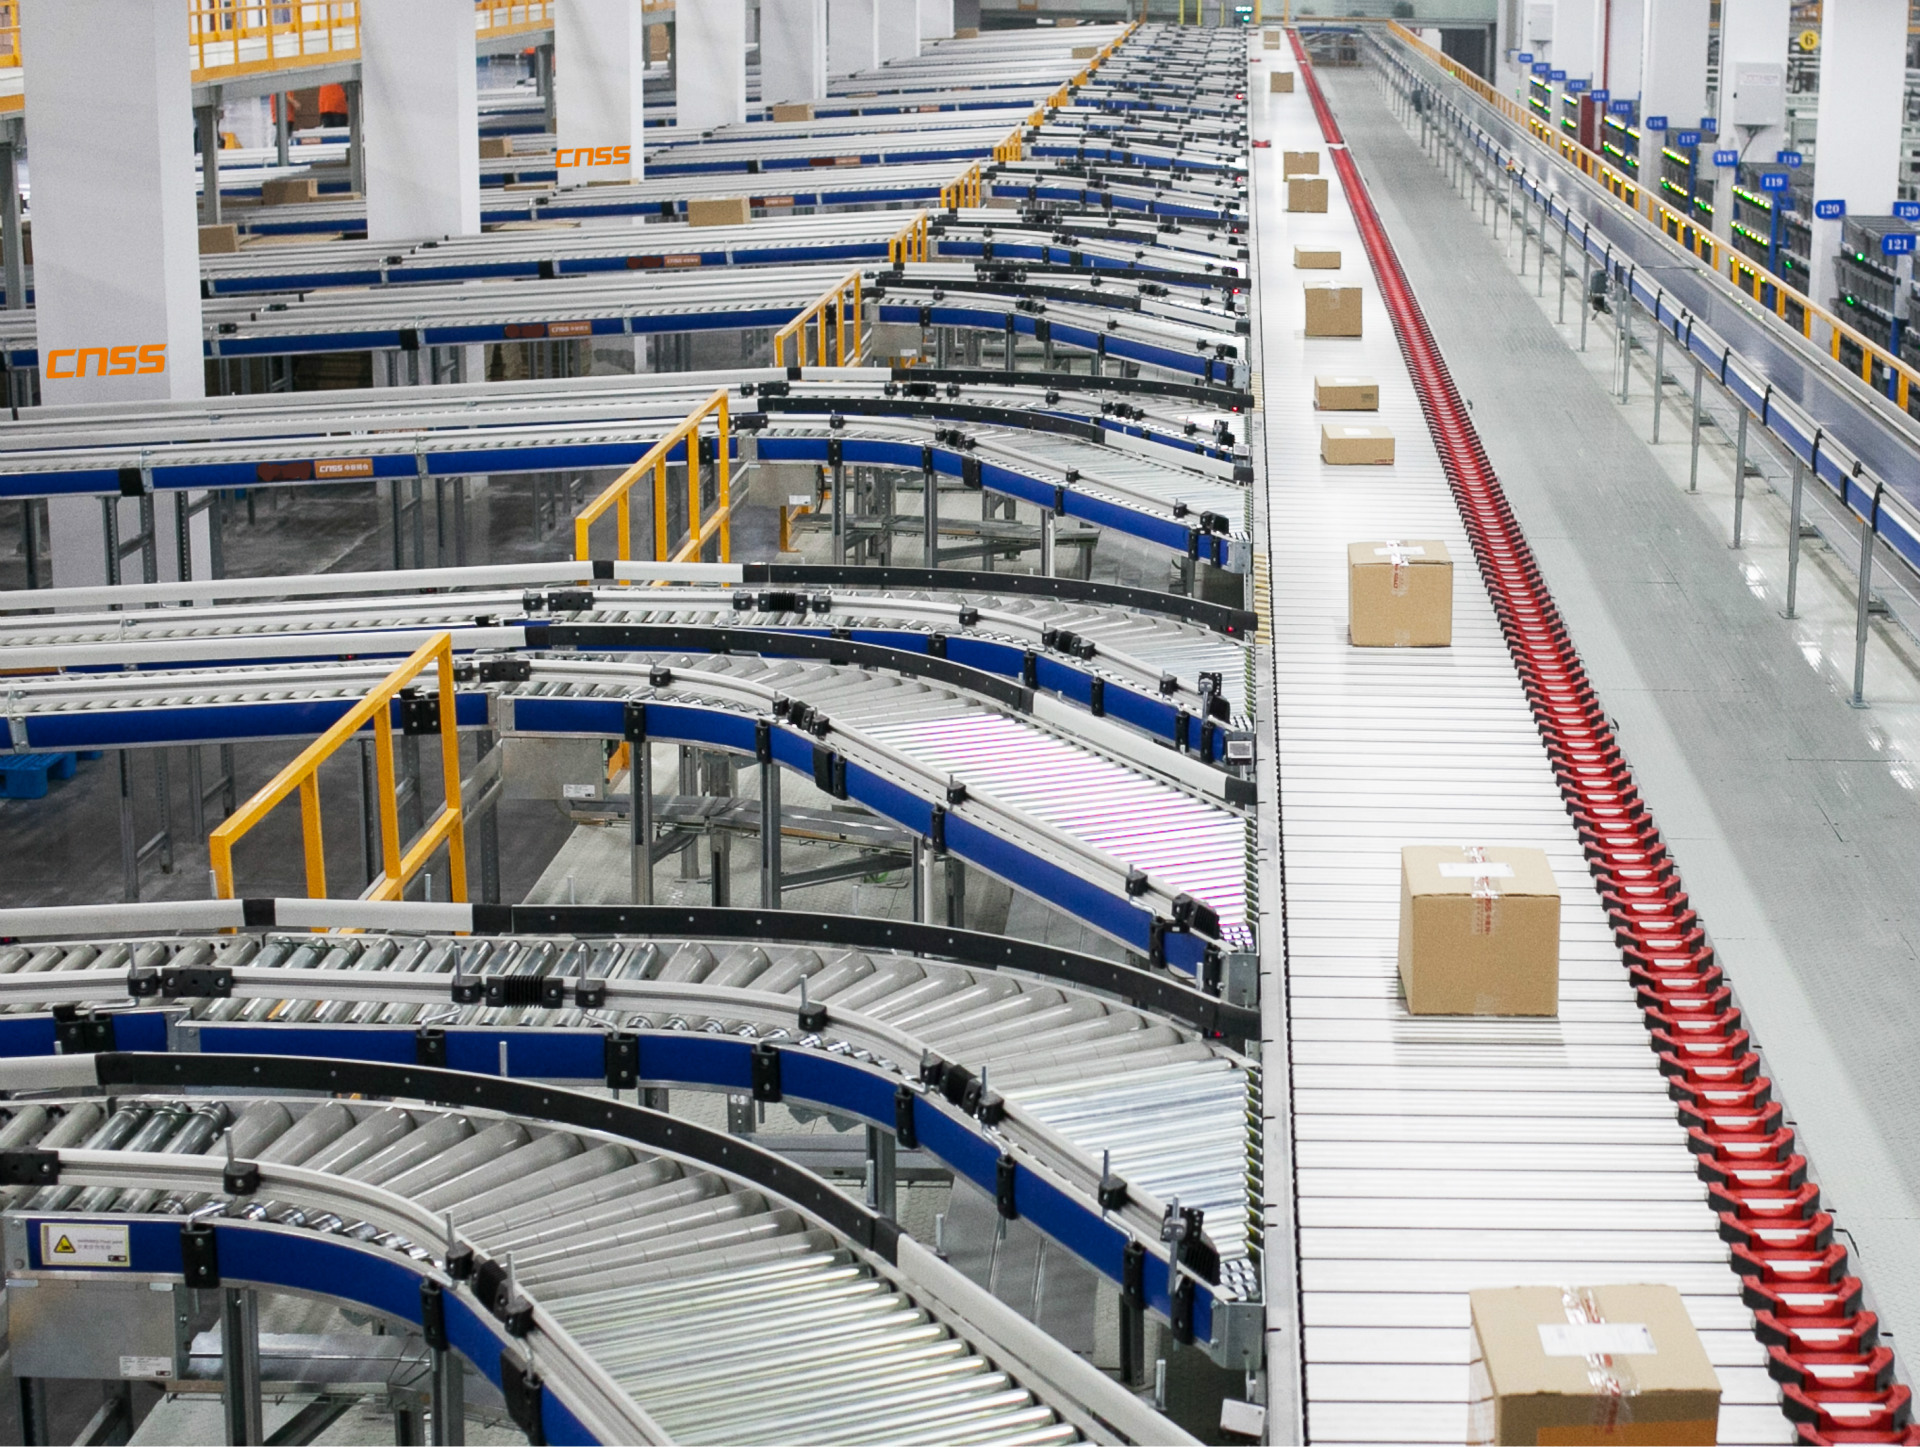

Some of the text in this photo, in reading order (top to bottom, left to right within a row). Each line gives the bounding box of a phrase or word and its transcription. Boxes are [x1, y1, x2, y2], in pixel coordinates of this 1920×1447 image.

[1805, 33, 1814, 46] 6
[1680, 134, 1697, 143] 117
[1717, 153, 1734, 162] 118
[1782, 156, 1799, 164] 118
[1764, 177, 1783, 187] 119
[1820, 204, 1840, 215] 120
[1900, 206, 1919, 217] 120
[1888, 239, 1908, 251] 121
